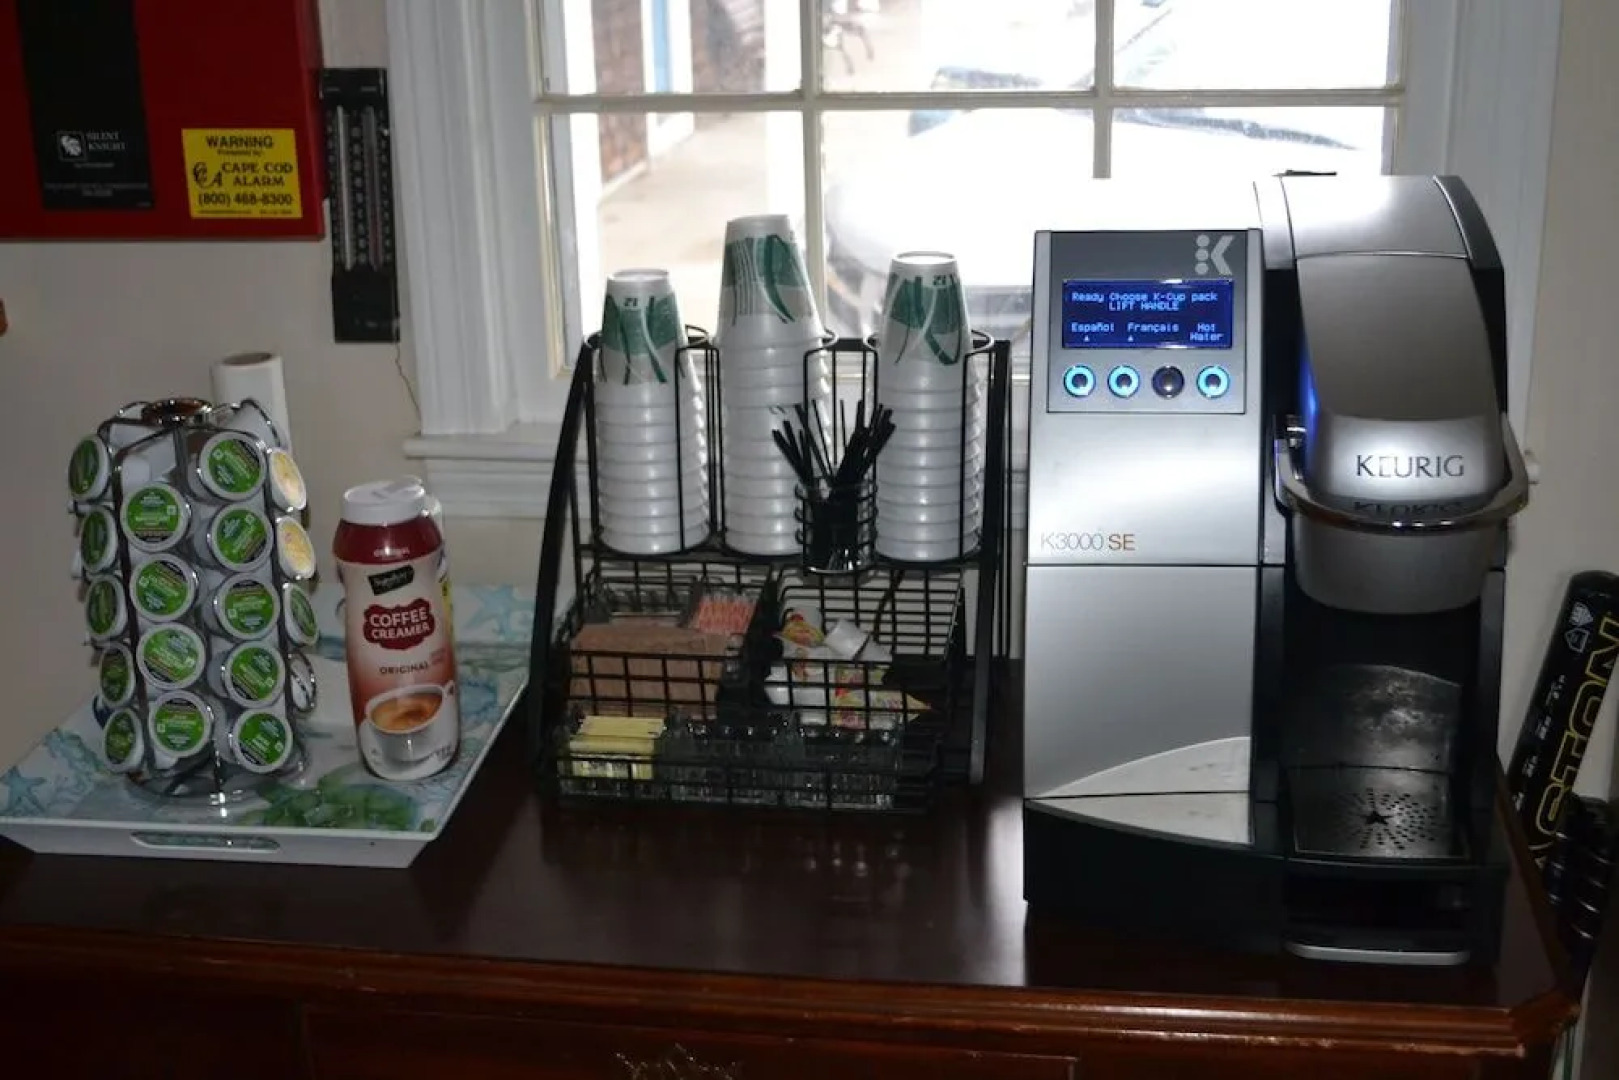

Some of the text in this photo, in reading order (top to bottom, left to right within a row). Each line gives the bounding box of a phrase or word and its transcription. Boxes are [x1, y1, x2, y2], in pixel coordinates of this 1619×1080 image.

[206, 135, 274, 149] WARNING
[222, 162, 293, 173] CAPE COD
[233, 175, 285, 187] ALARM
[198, 192, 231, 207] (800)
[1071, 292, 1218, 303] Ready Choose K-Cup pack
[1108, 301, 1180, 311] LIFT HANDLE
[1071, 321, 1216, 334] Español Français Hot
[1189, 332, 1224, 342] Water
[1356, 454, 1465, 478] KEURIG
[1040, 531, 1136, 551] K3000 SE
[370, 606, 428, 627] COFFEE
[371, 621, 431, 639] CREAMER
[379, 660, 429, 674] ORIGINAL
